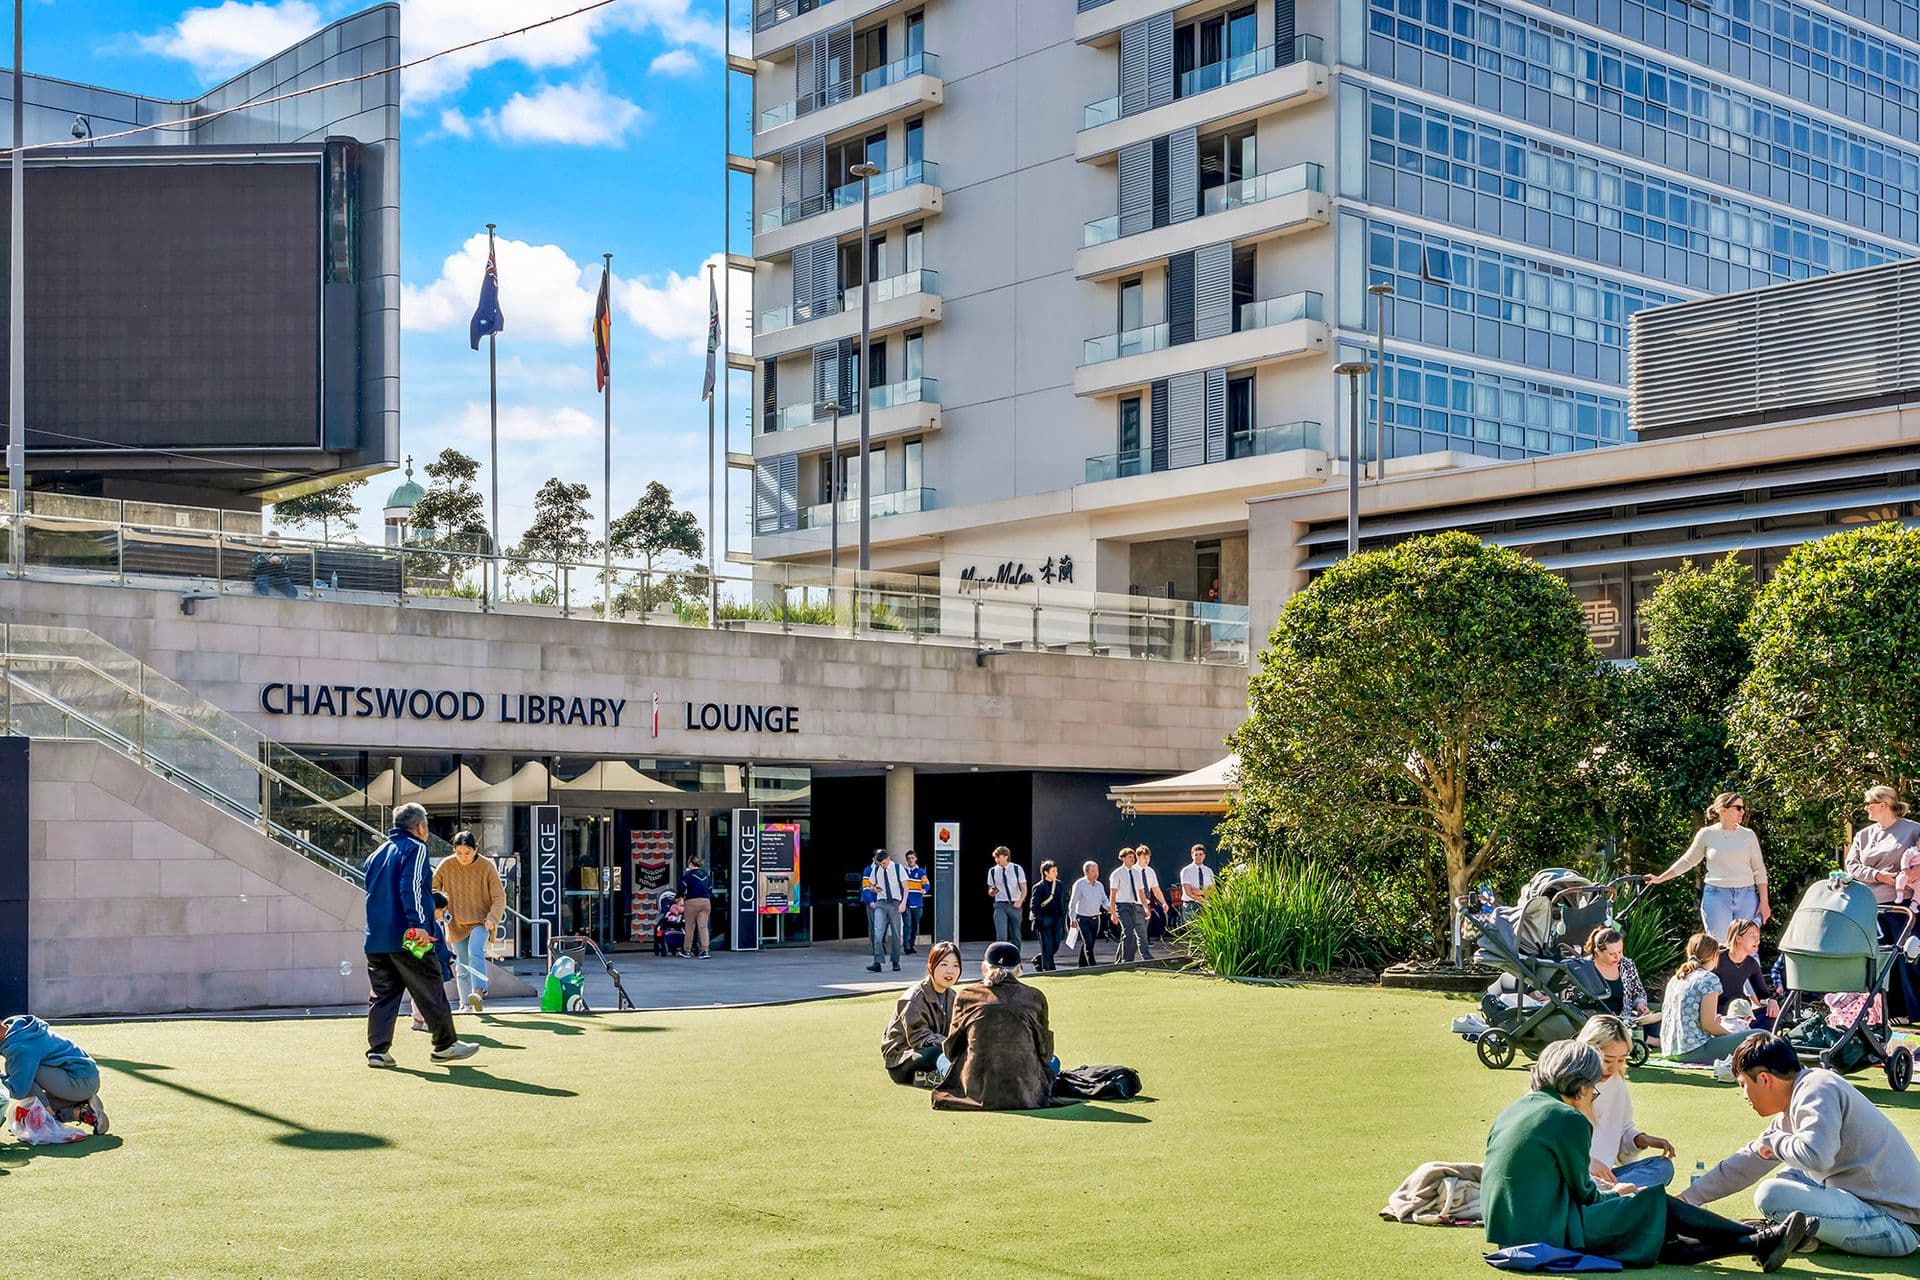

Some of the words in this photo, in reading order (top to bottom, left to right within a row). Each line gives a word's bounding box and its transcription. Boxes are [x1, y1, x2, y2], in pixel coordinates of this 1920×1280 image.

[1039, 555, 1073, 584] 木蘭
[260, 682, 484, 721] CHATSWOOD
[500, 693, 627, 727] LIBRARY
[685, 702, 800, 734] LOUNGE
[541, 823, 557, 916] LOUNGE
[740, 825, 756, 912] LOUNGE
